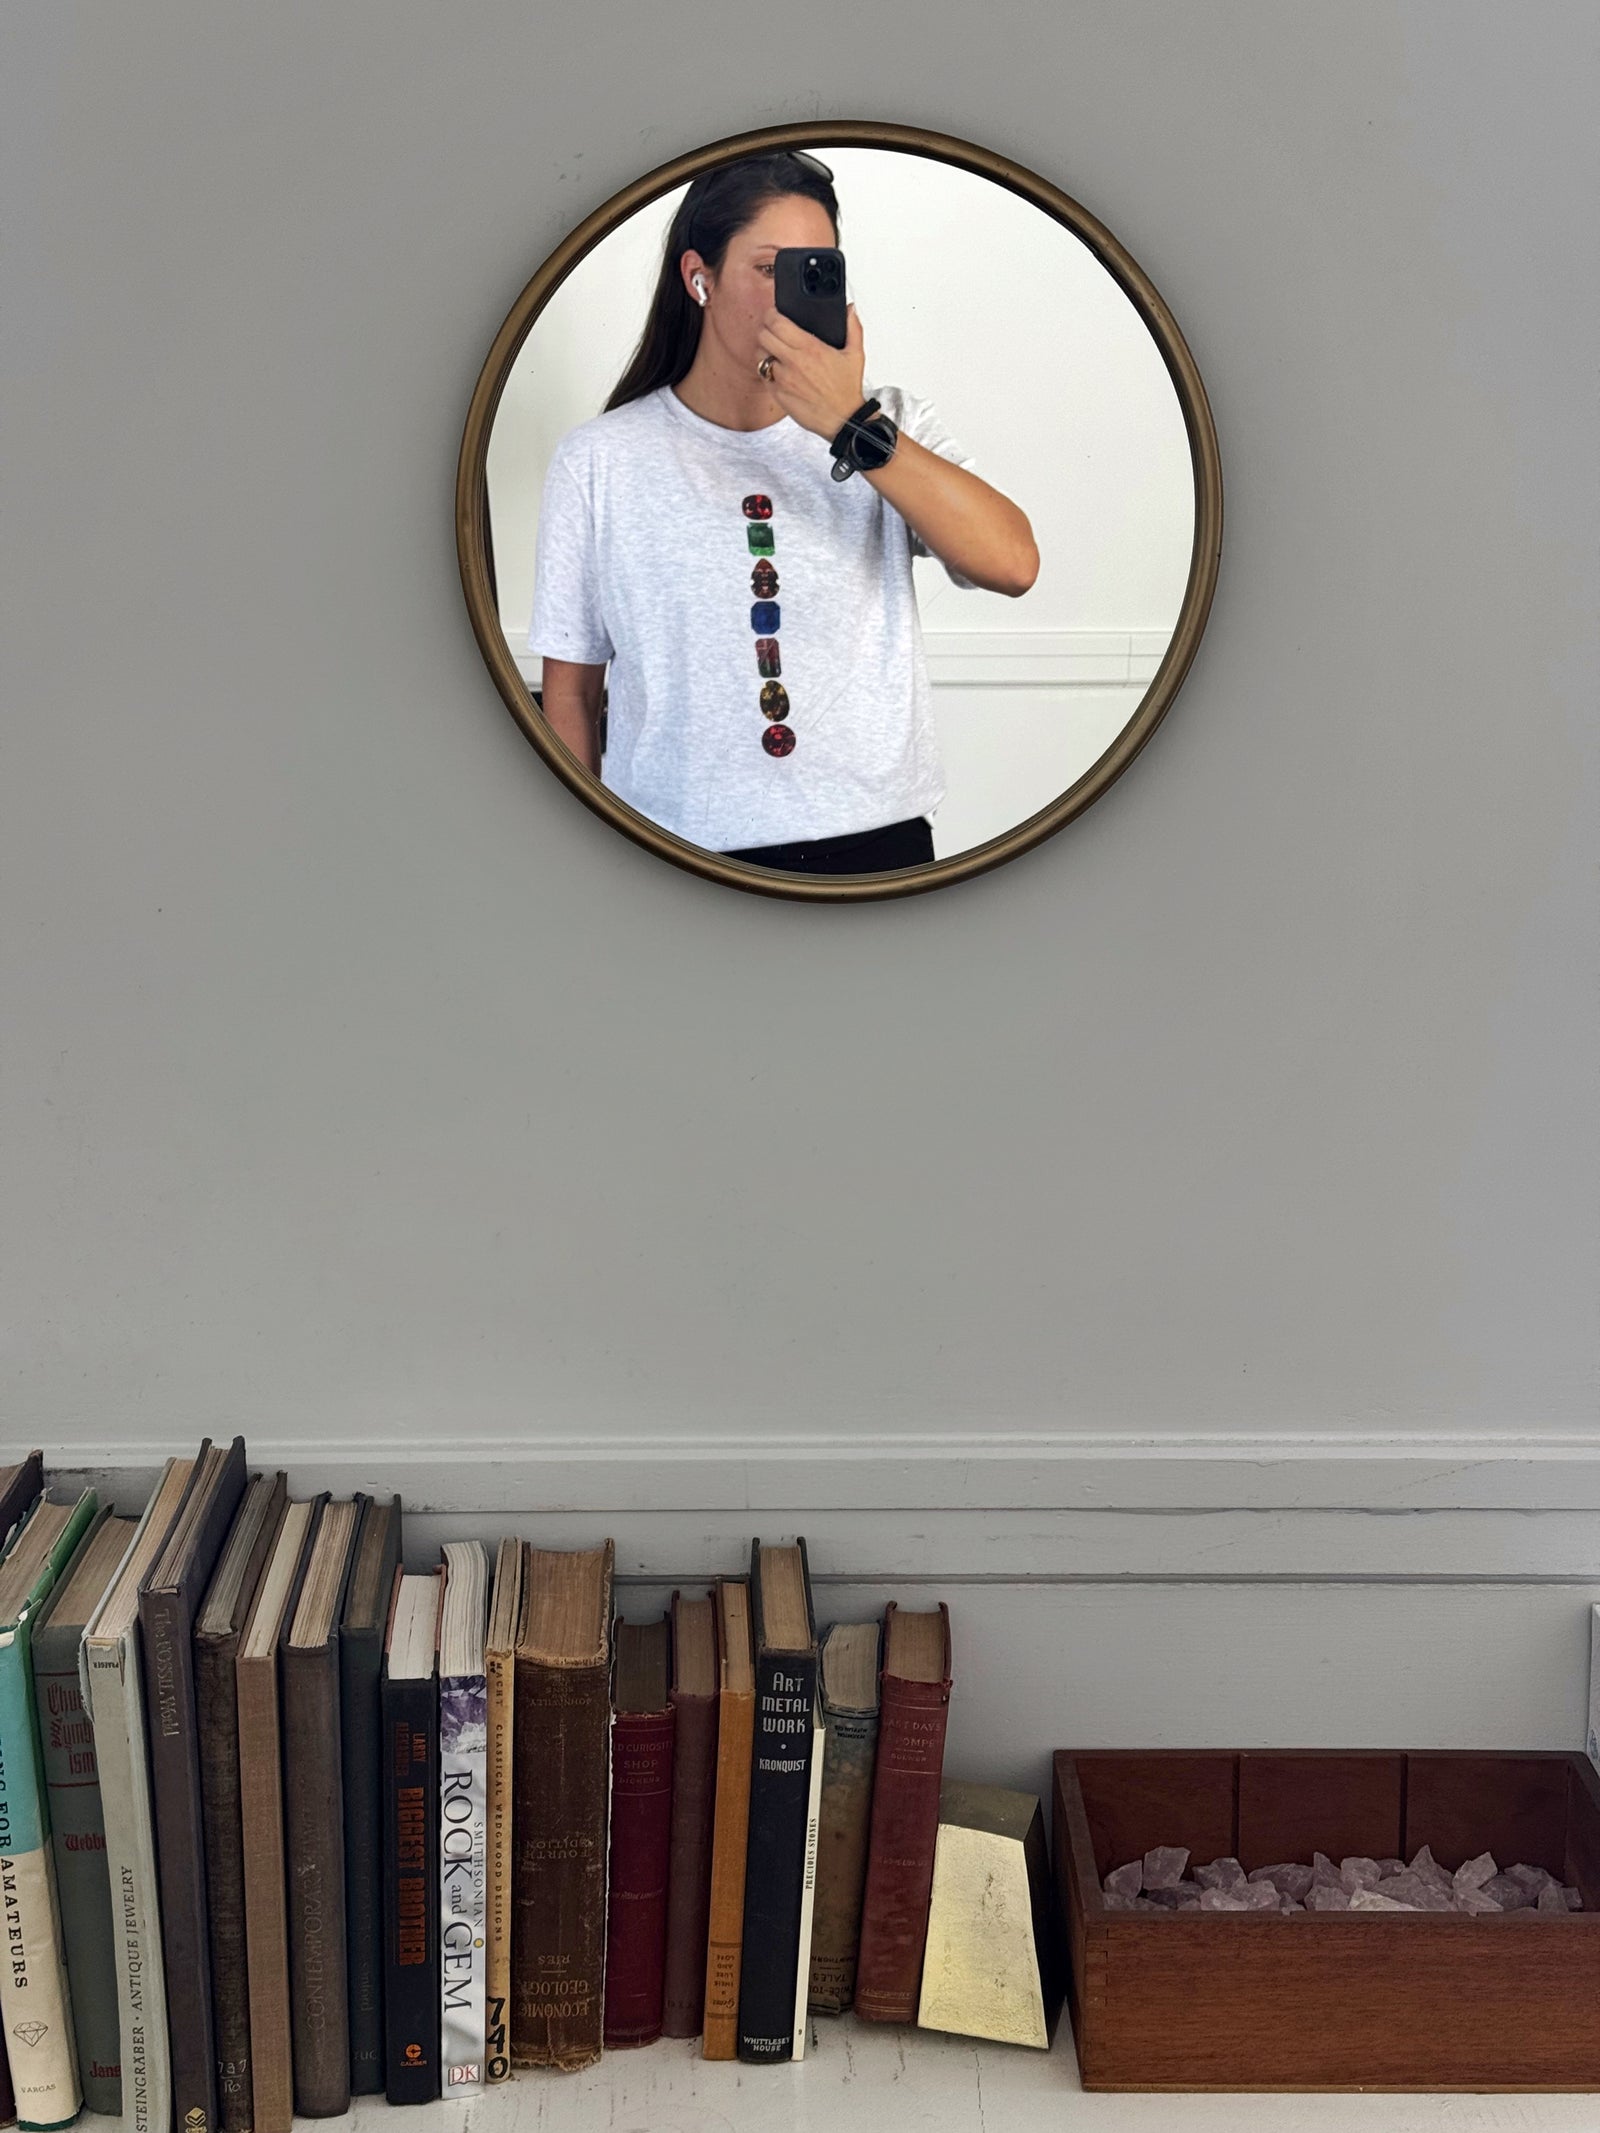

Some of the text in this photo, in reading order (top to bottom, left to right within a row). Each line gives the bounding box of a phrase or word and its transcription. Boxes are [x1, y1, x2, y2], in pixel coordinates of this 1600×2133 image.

[773, 1671, 804, 1692] ART
[762, 1696, 810, 1713] METAL
[762, 1716, 806, 1734] WORK
[913, 1721, 942, 1732] DAYS
[413, 1733, 426, 1761] LARRY
[495, 1724, 504, 1796] CLASSICAL
[623, 1759, 658, 1769] SHOP
[759, 1758, 808, 1773] KRONQUIST
[495, 1804, 504, 1879] WEDGWOOD
[524, 1849, 588, 1860] FOURTH
[805, 1817, 817, 1890] PRECIOUS STONES
[397, 1787, 426, 1965] BIGGEST BROTHER
[473, 1821, 484, 1928] SMITHSONIAN
[443, 1769, 473, 2013] ROCK and GEM
[494, 1885, 503, 1942] DESIGNS
[1, 1858, 28, 1988] AMATEURS
[537, 1955, 570, 1966] RIES
[812, 1973, 846, 1983] TALES
[121, 1866, 148, 2133] STEINGRABER ANTIQUE JEWELRY
[519, 2000, 588, 2018] ECONOMIC
[753, 2044, 782, 2052] HOUSE
[217, 2059, 247, 2074] 737
[451, 2065, 476, 2083] DK
[20, 2083, 57, 2093] VARGAS
